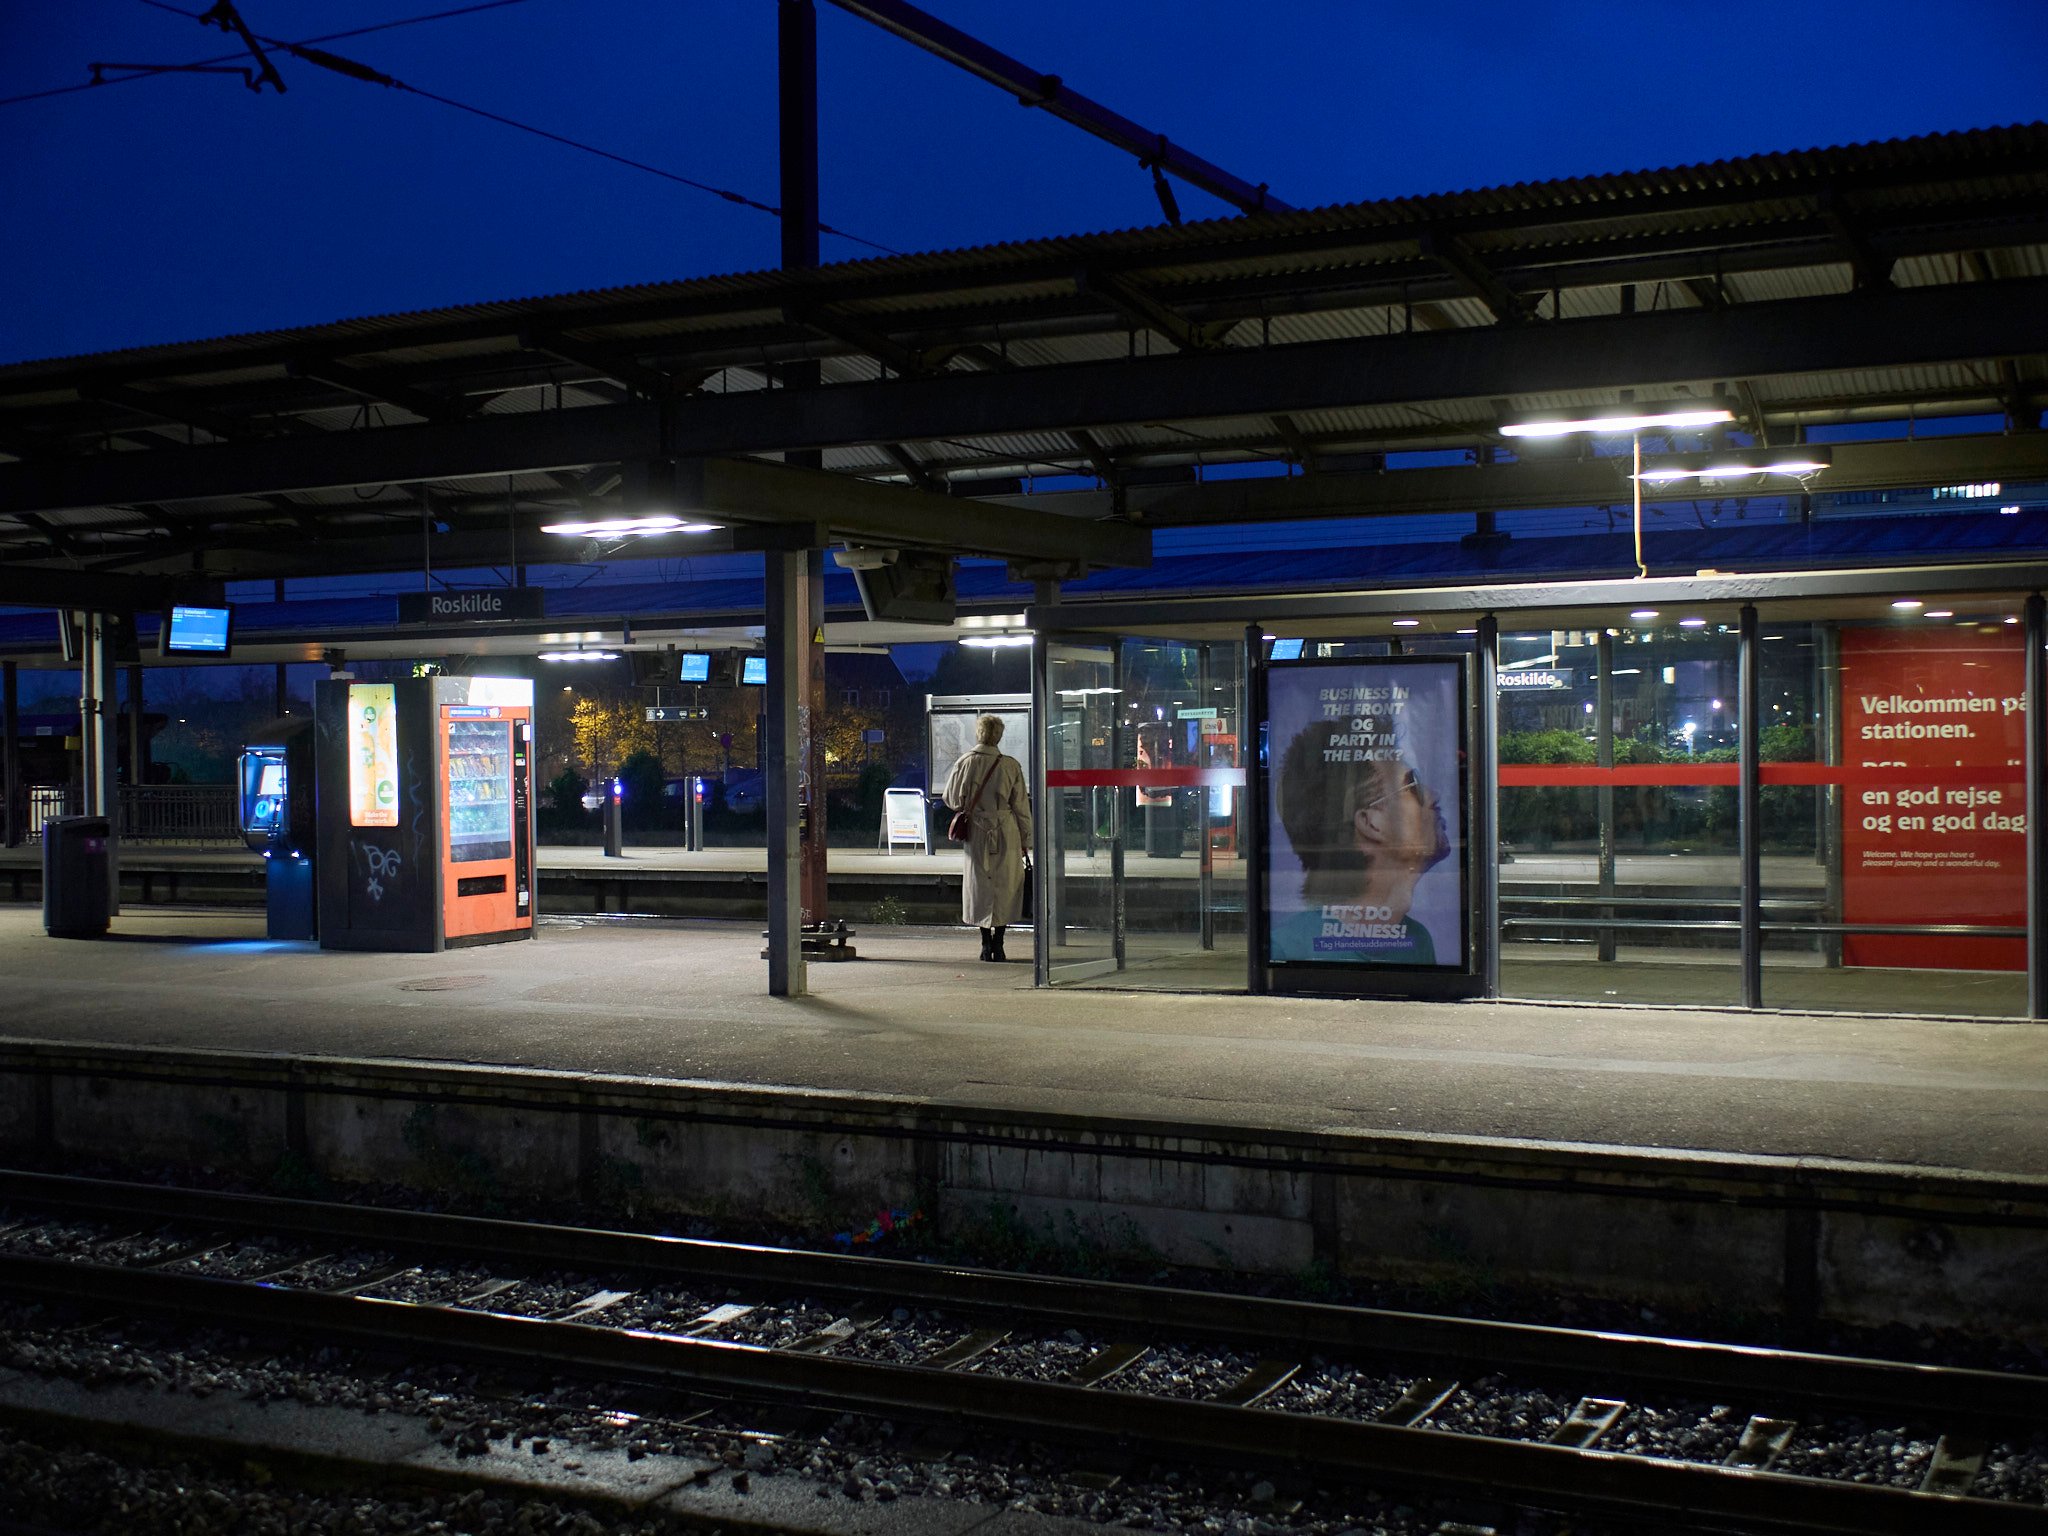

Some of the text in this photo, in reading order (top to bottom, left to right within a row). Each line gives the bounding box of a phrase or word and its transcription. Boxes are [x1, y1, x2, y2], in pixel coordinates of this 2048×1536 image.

[432, 593, 502, 614] Roskilde
[1497, 672, 1556, 686] Roskilde
[1320, 687, 1410, 700] BUSINESS IN
[1323, 702, 1404, 716] THE FRONT
[1860, 695, 1997, 714] Velkommen
[1351, 718, 1374, 732] OG
[1861, 720, 1977, 740] stationen.
[1329, 733, 1396, 746] PARTY IN
[1323, 749, 1404, 761] THE BACK?
[1862, 786, 2002, 808] en god rejse
[1862, 815, 1892, 833] og
[1897, 816, 1926, 830] en
[1932, 811, 1976, 833] god
[1863, 850, 1898, 858] Welcome.
[1900, 850, 1914, 858] We
[1914, 850, 1933, 859] hope
[1949, 850, 1968, 858] have
[1862, 860, 1893, 868] pleasant
[1894, 860, 1922, 868] journey
[1984, 860, 2001, 868] day.
[1321, 905, 1393, 920] LET'S DO
[1321, 922, 1407, 939] BUSINESS!
[1320, 940, 1333, 950] Tag
[1335, 940, 1413, 948] Handelsuddannelsen
